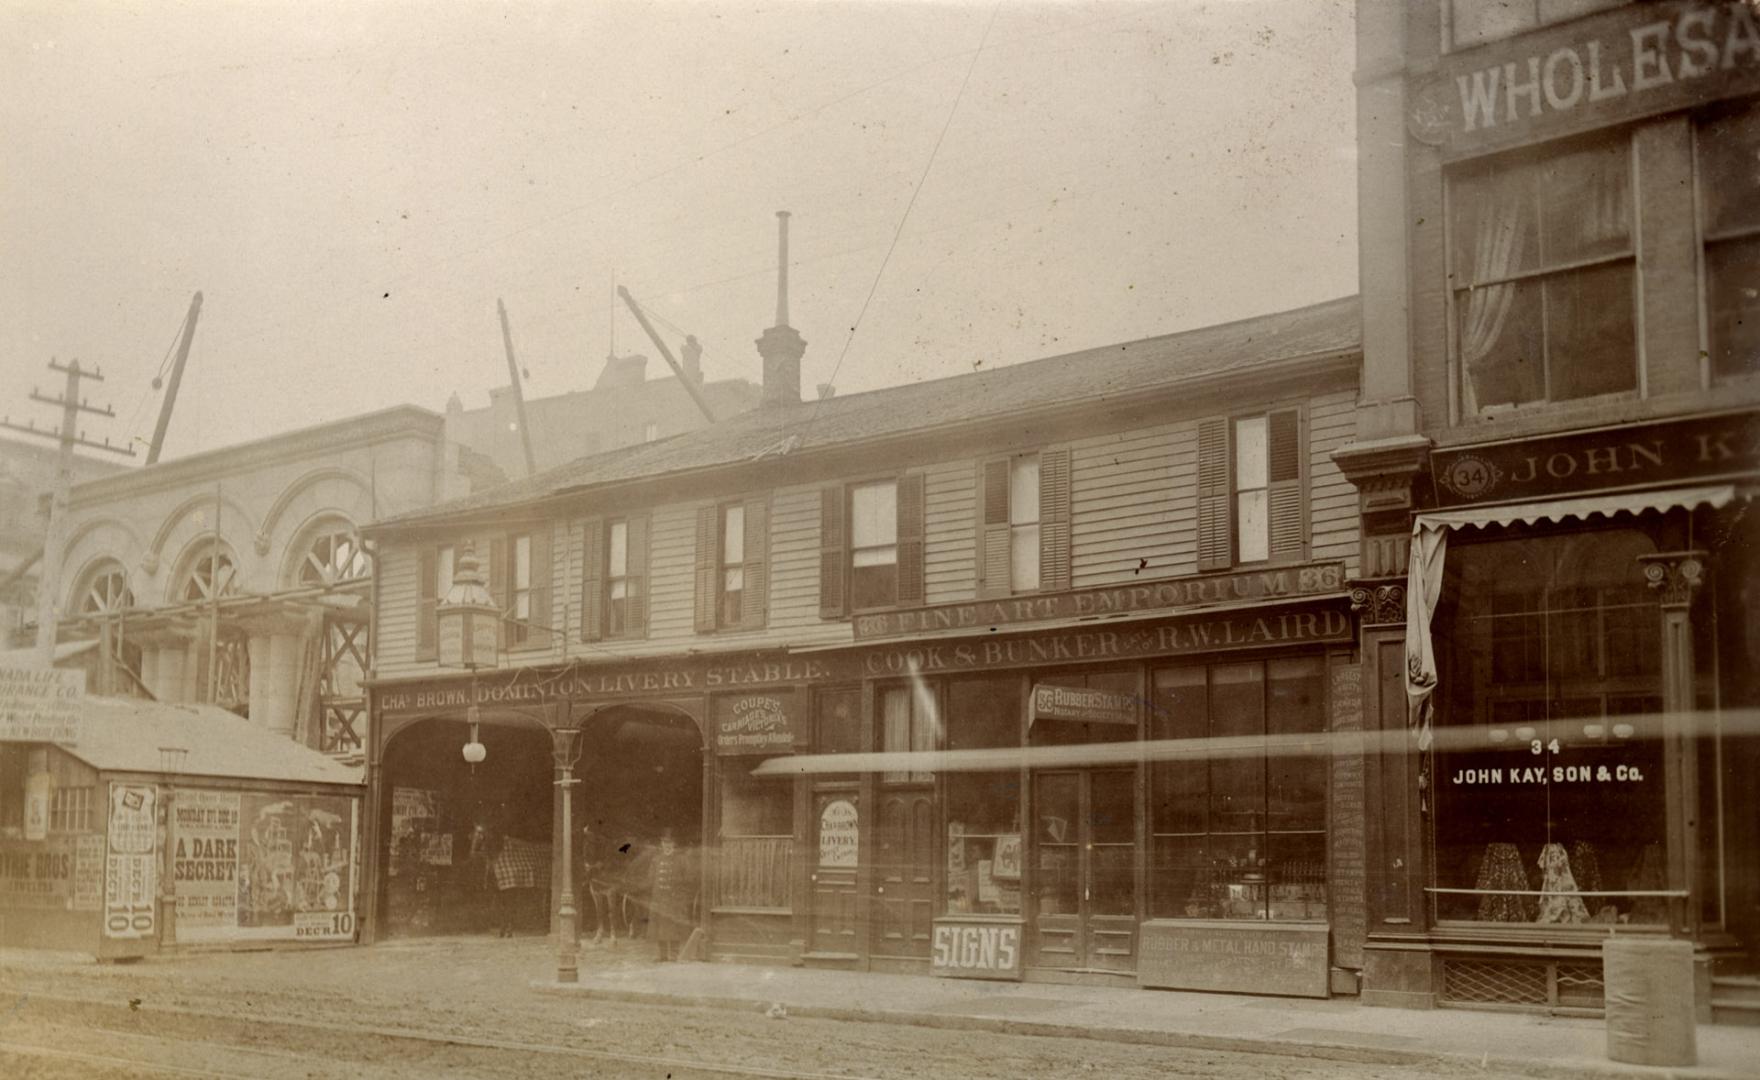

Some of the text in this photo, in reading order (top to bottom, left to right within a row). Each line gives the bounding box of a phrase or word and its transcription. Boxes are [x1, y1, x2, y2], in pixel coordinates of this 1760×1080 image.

[1510, 428, 1760, 483] JOHN K
[1457, 467, 1485, 487] 34
[898, 606, 977, 631] FINE
[990, 597, 1059, 624] ART
[1073, 572, 1288, 614] EMPORIUM
[1300, 564, 1340, 593] 36
[866, 646, 946, 674] COOK
[954, 645, 977, 665] &
[983, 631, 1120, 665] BUNKER
[477, 677, 593, 703] DOMINION
[599, 670, 697, 693] LIVERY
[1039, 690, 1053, 710] 36
[1530, 739, 1560, 755] 34
[1453, 769, 1503, 785] JOHN
[1510, 768, 1548, 785] KAY,
[1553, 766, 1591, 782] SON
[1597, 766, 1612, 781] &
[176, 838, 237, 859] A DARK
[175, 861, 237, 881] SECRET
[108, 905, 129, 932] 10
[132, 904, 152, 931] 10
[333, 913, 352, 935] 10
[933, 926, 1017, 971] SIGNS
[1142, 936, 1189, 952] RUBBER
[1202, 938, 1240, 955] METAL
[1244, 940, 1276, 956] HAND
